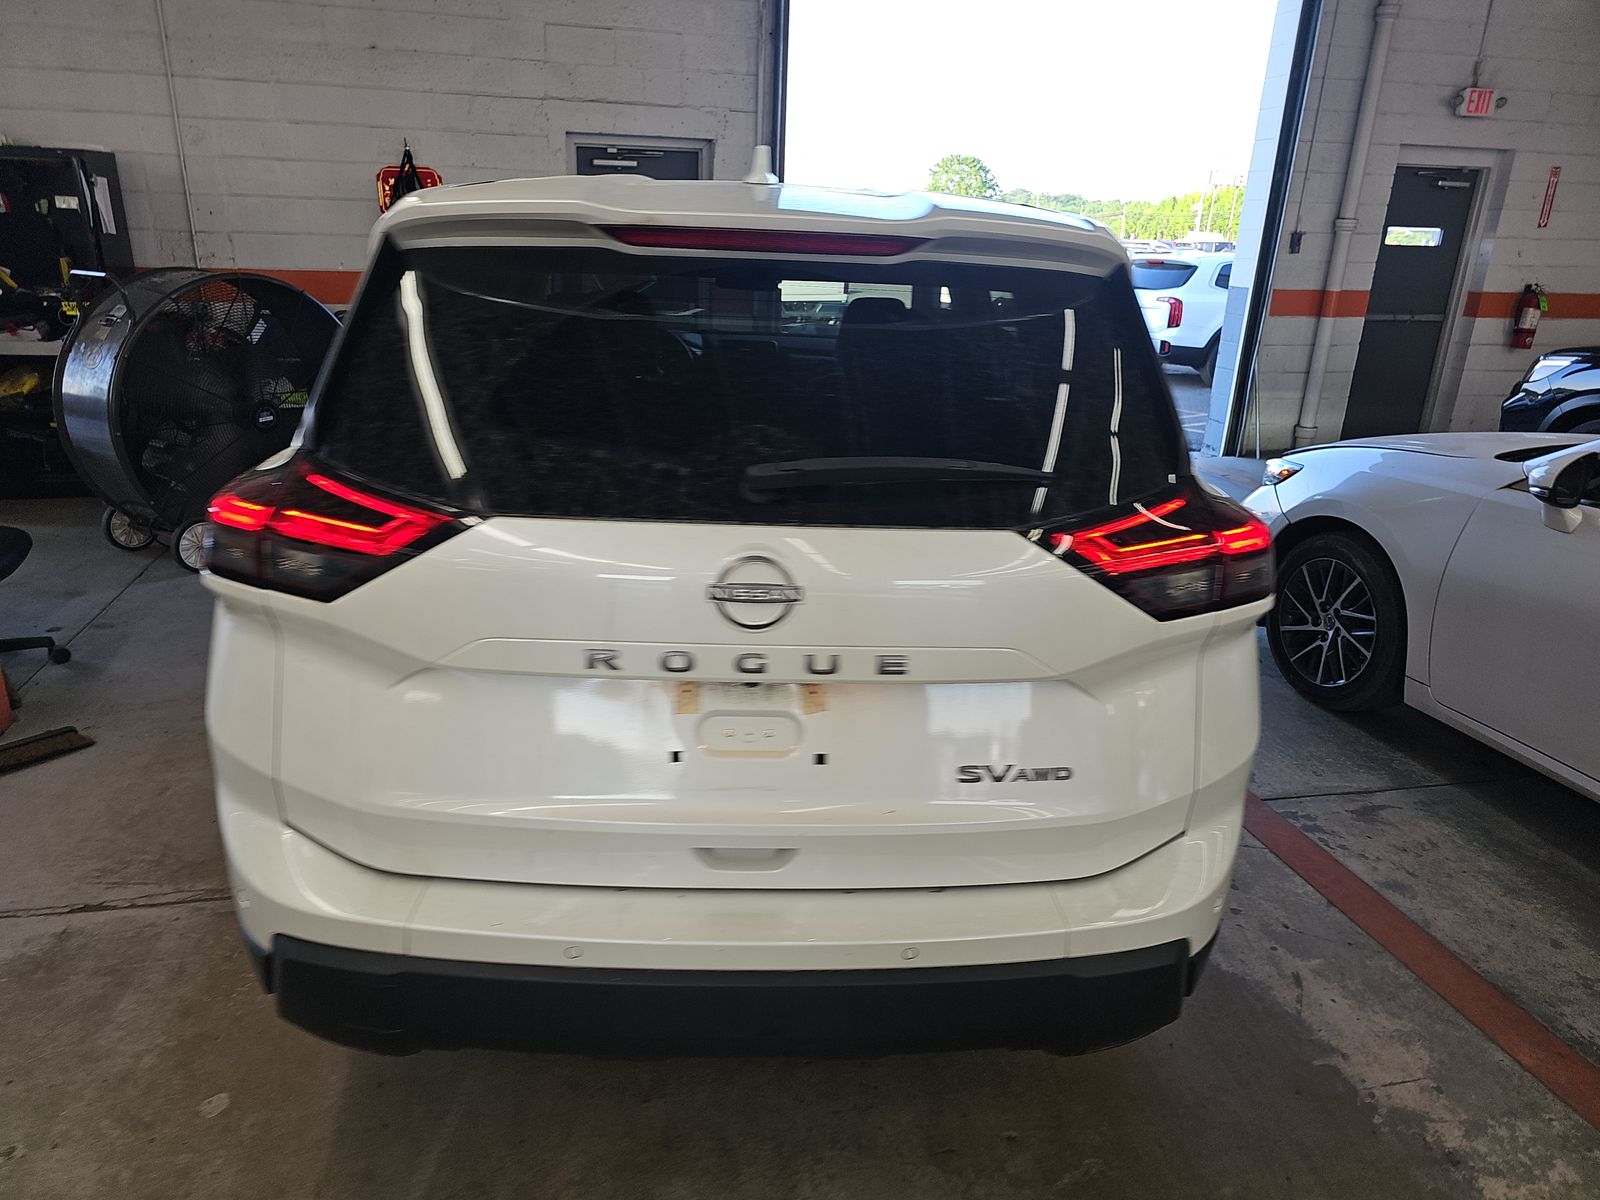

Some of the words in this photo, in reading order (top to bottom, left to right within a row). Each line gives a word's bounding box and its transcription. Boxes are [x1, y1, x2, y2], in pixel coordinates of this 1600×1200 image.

[1465, 89, 1494, 114] EXIT
[708, 586, 802, 601] NISSAN
[584, 648, 910, 676] ROGUE
